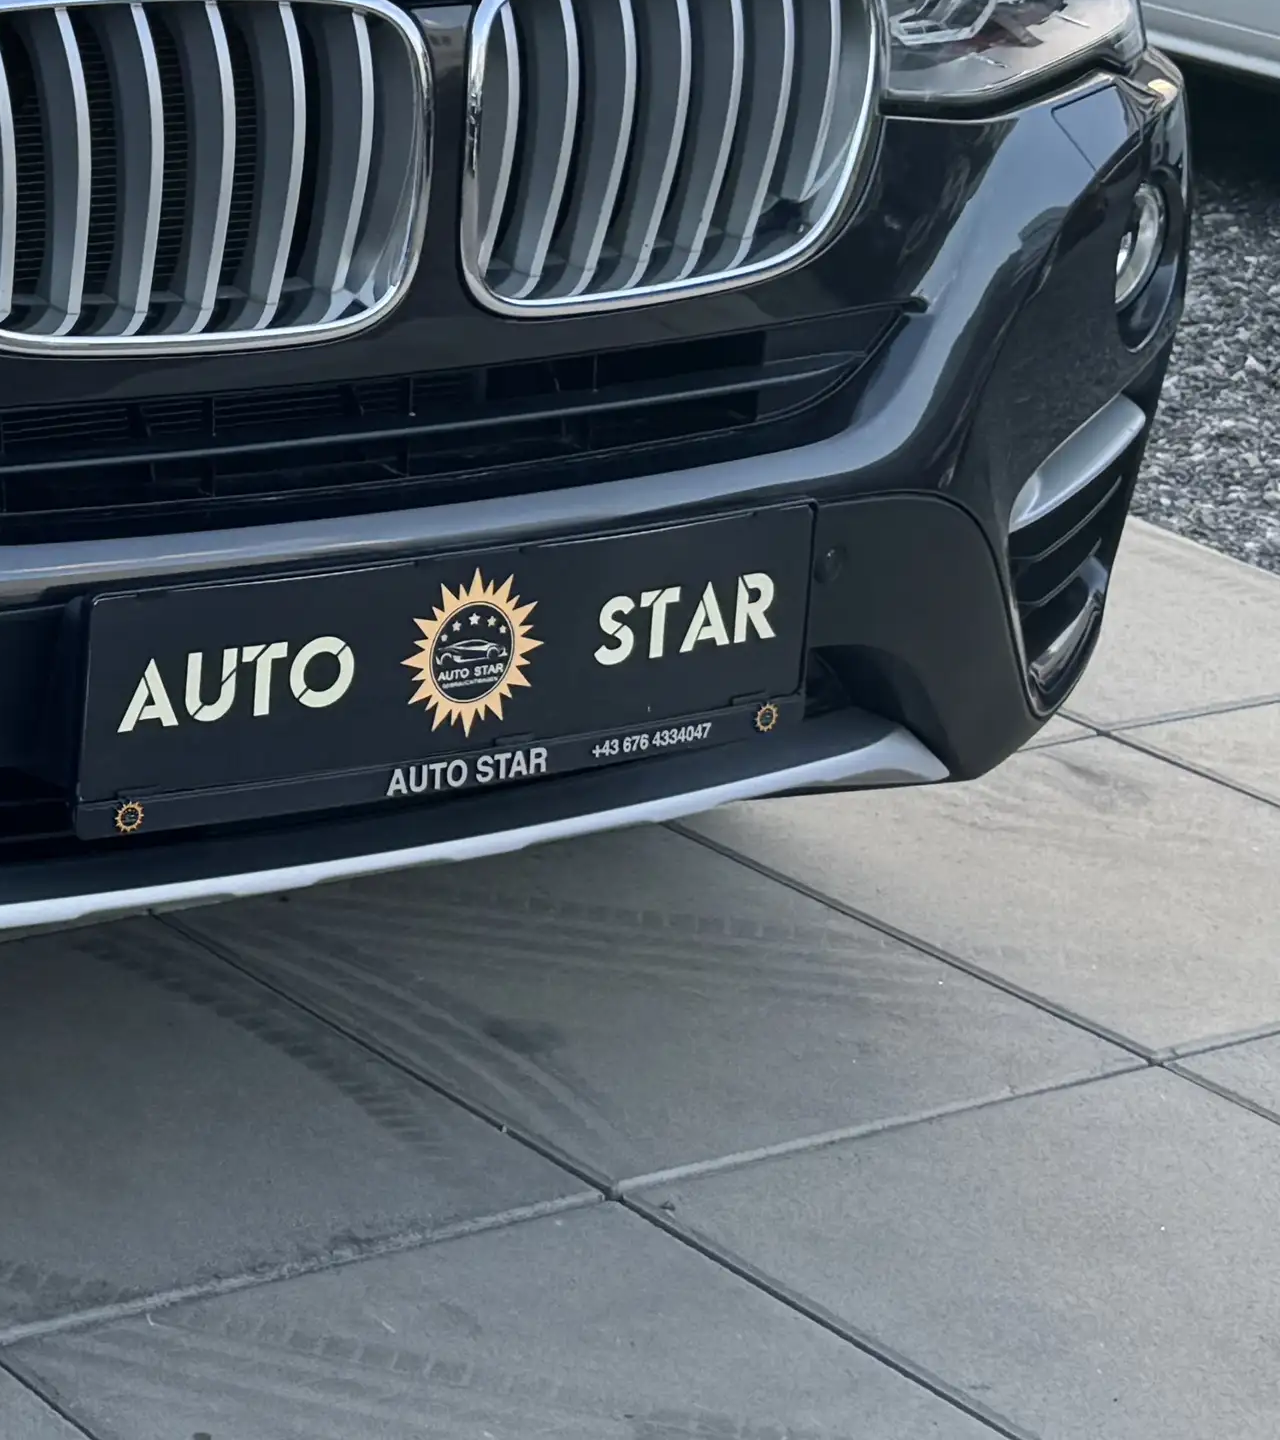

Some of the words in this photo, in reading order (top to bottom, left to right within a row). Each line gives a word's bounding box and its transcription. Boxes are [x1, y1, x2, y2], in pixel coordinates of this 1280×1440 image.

[117, 636, 355, 734] AUTO
[593, 572, 776, 667] STAR
[438, 668, 470, 681] AUTO
[474, 663, 504, 677] STAR
[592, 738, 620, 758] +43
[622, 733, 650, 753] 676
[651, 722, 712, 748] 4334047
[386, 759, 468, 797] AUTO
[475, 747, 548, 783] STAR
